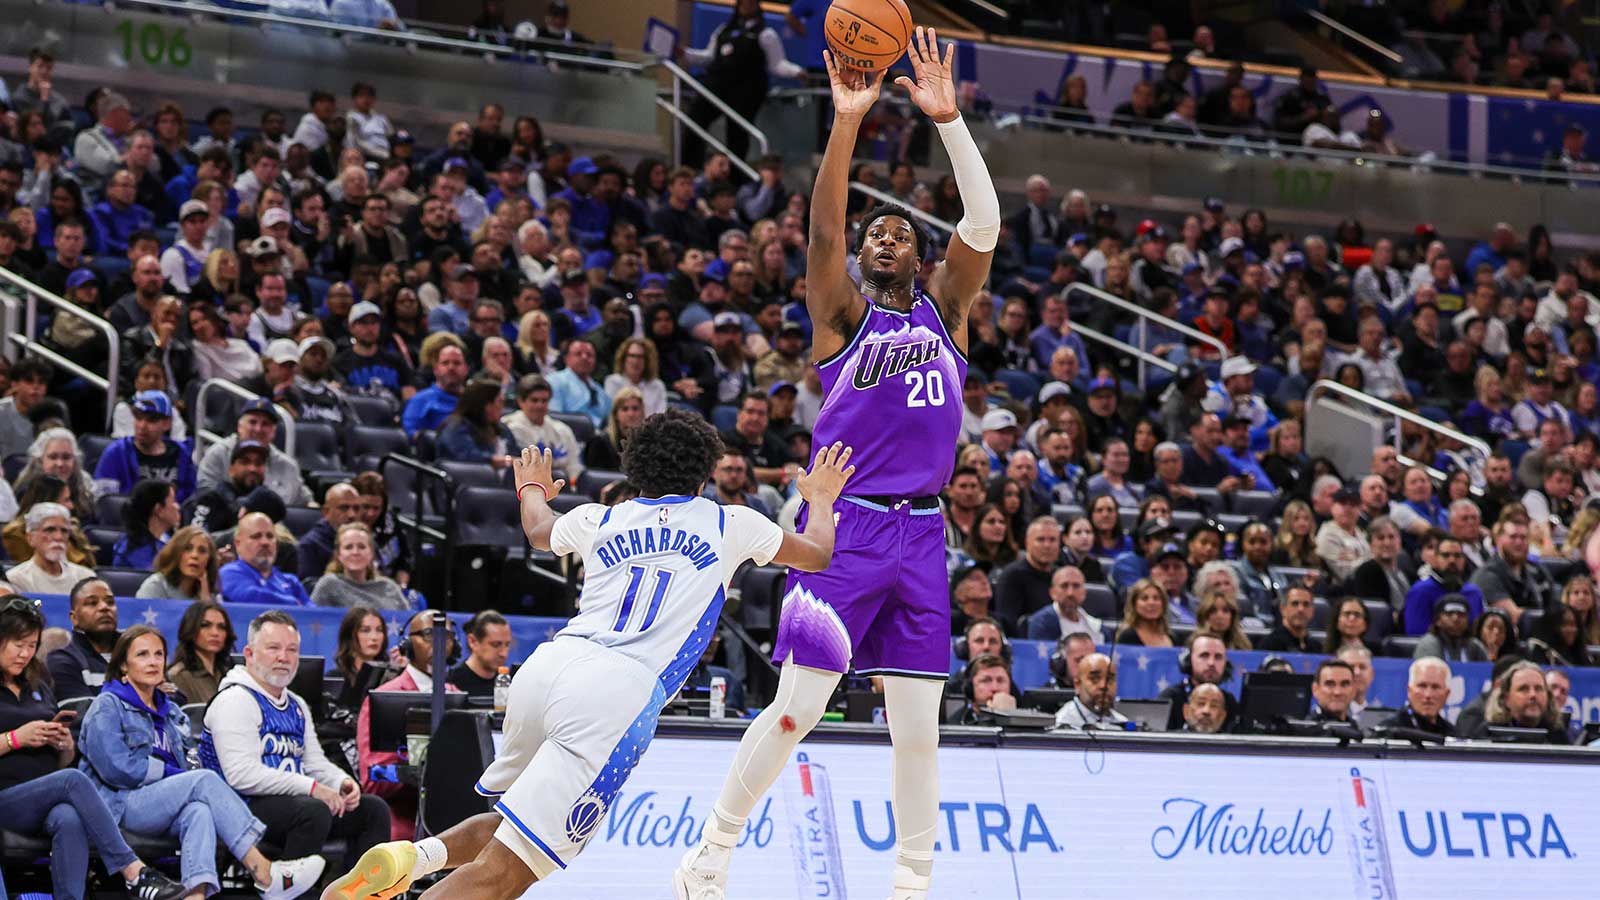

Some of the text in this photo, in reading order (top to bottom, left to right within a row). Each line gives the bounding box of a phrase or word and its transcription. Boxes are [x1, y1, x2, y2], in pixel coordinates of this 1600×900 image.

[112, 18, 192, 69] 106
[852, 338, 941, 391] UTAH
[905, 370, 945, 407] 20
[596, 527, 719, 571] RICHARDSON
[610, 564, 677, 633] 11
[804, 805, 831, 898] ULTRA
[1151, 798, 1333, 860] Michelob
